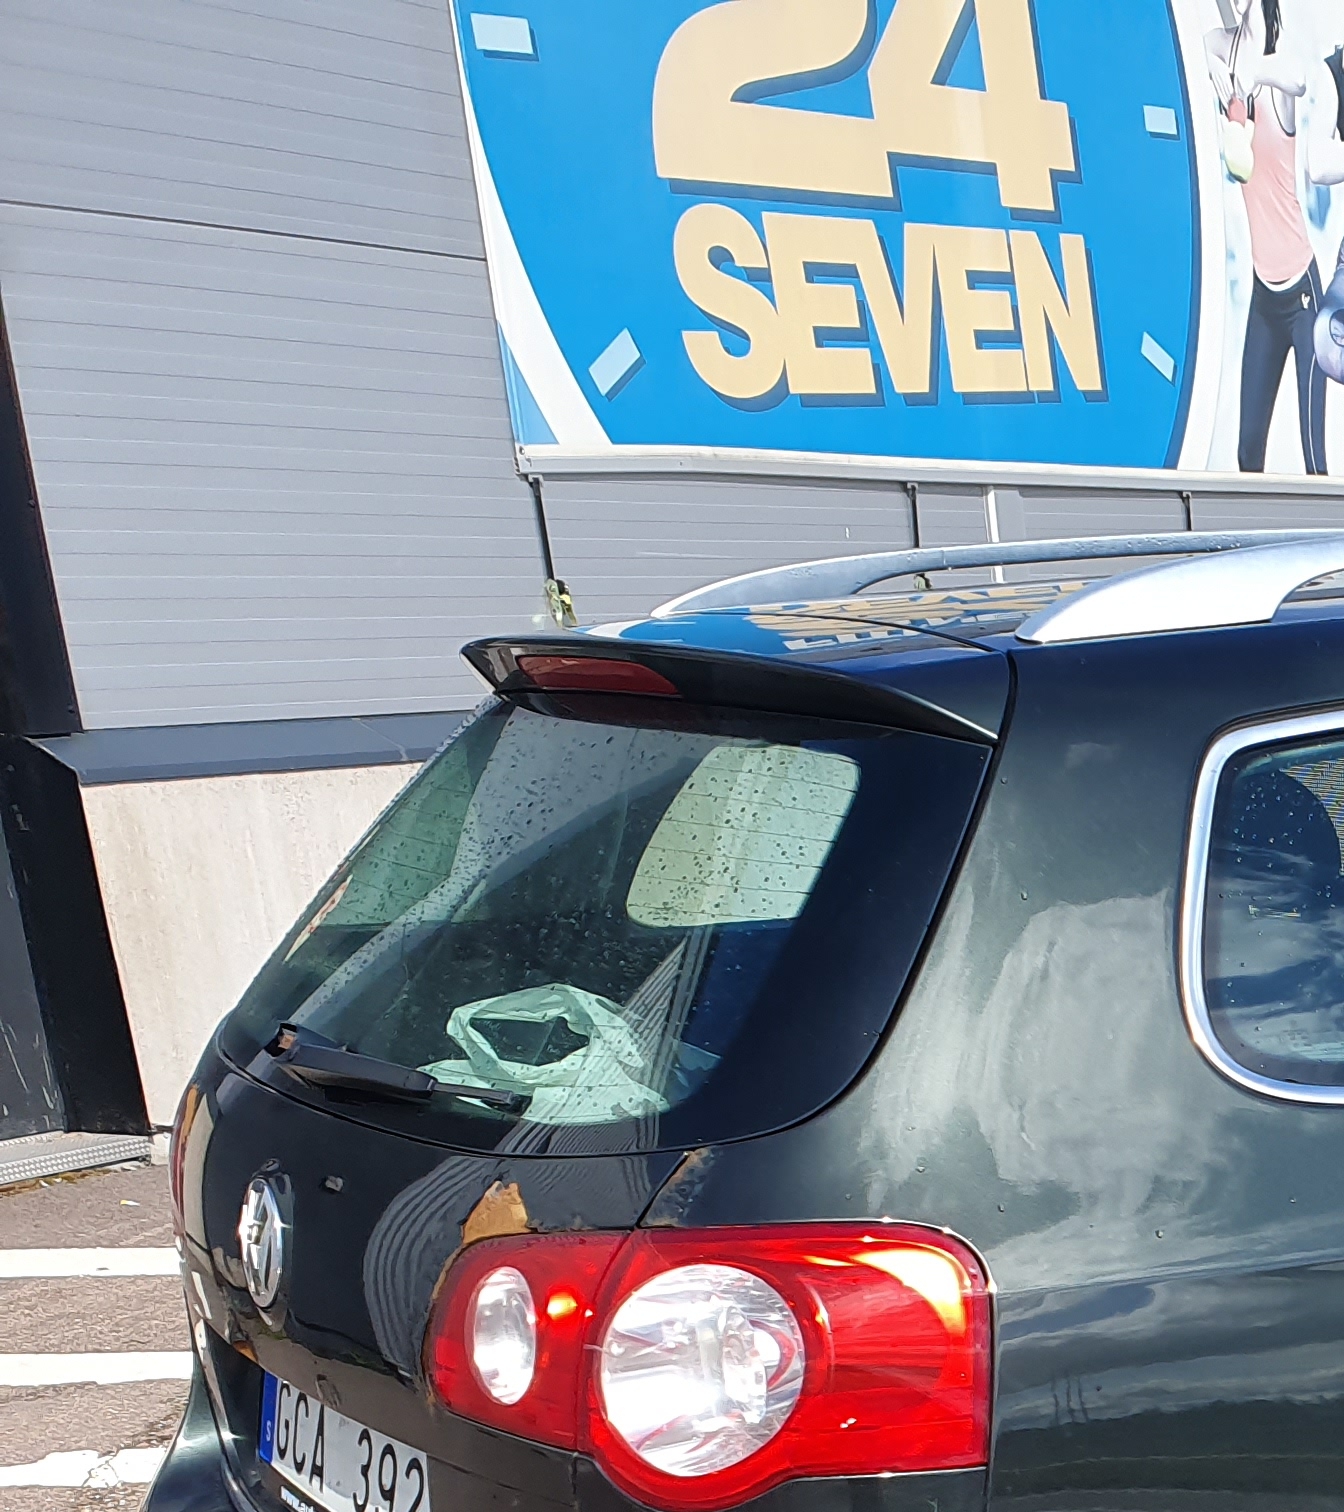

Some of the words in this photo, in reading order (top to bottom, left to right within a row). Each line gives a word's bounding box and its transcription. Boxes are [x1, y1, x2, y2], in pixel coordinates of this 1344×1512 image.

[652, 0, 1078, 214] 24
[673, 203, 1104, 404] SEVEN
[266, 1420, 273, 1442] S
[276, 1382, 325, 1493] GCA
